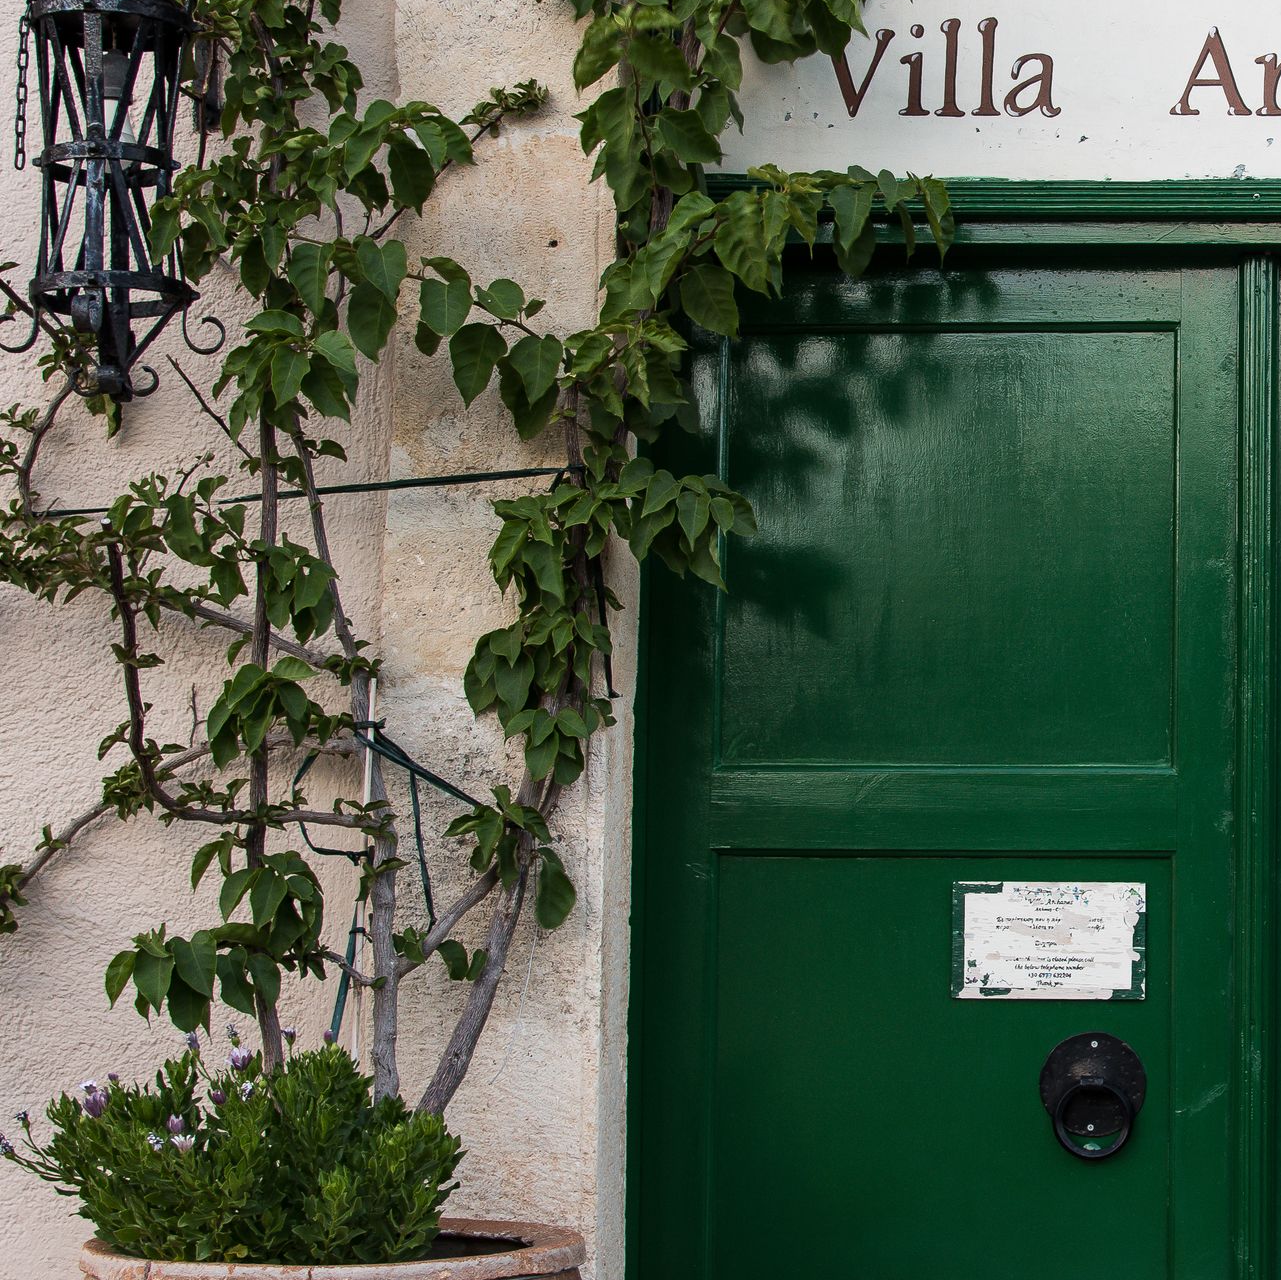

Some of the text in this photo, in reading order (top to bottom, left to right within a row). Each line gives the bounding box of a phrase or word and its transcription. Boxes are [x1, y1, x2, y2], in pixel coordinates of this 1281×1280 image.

[830, 16, 1062, 118] Villa
[1051, 955, 1068, 963] closed
[1024, 963, 1040, 971] below
[1040, 963, 1065, 972] telephone
[1065, 963, 1085, 971] number
[1036, 979, 1064, 988] Thank you
